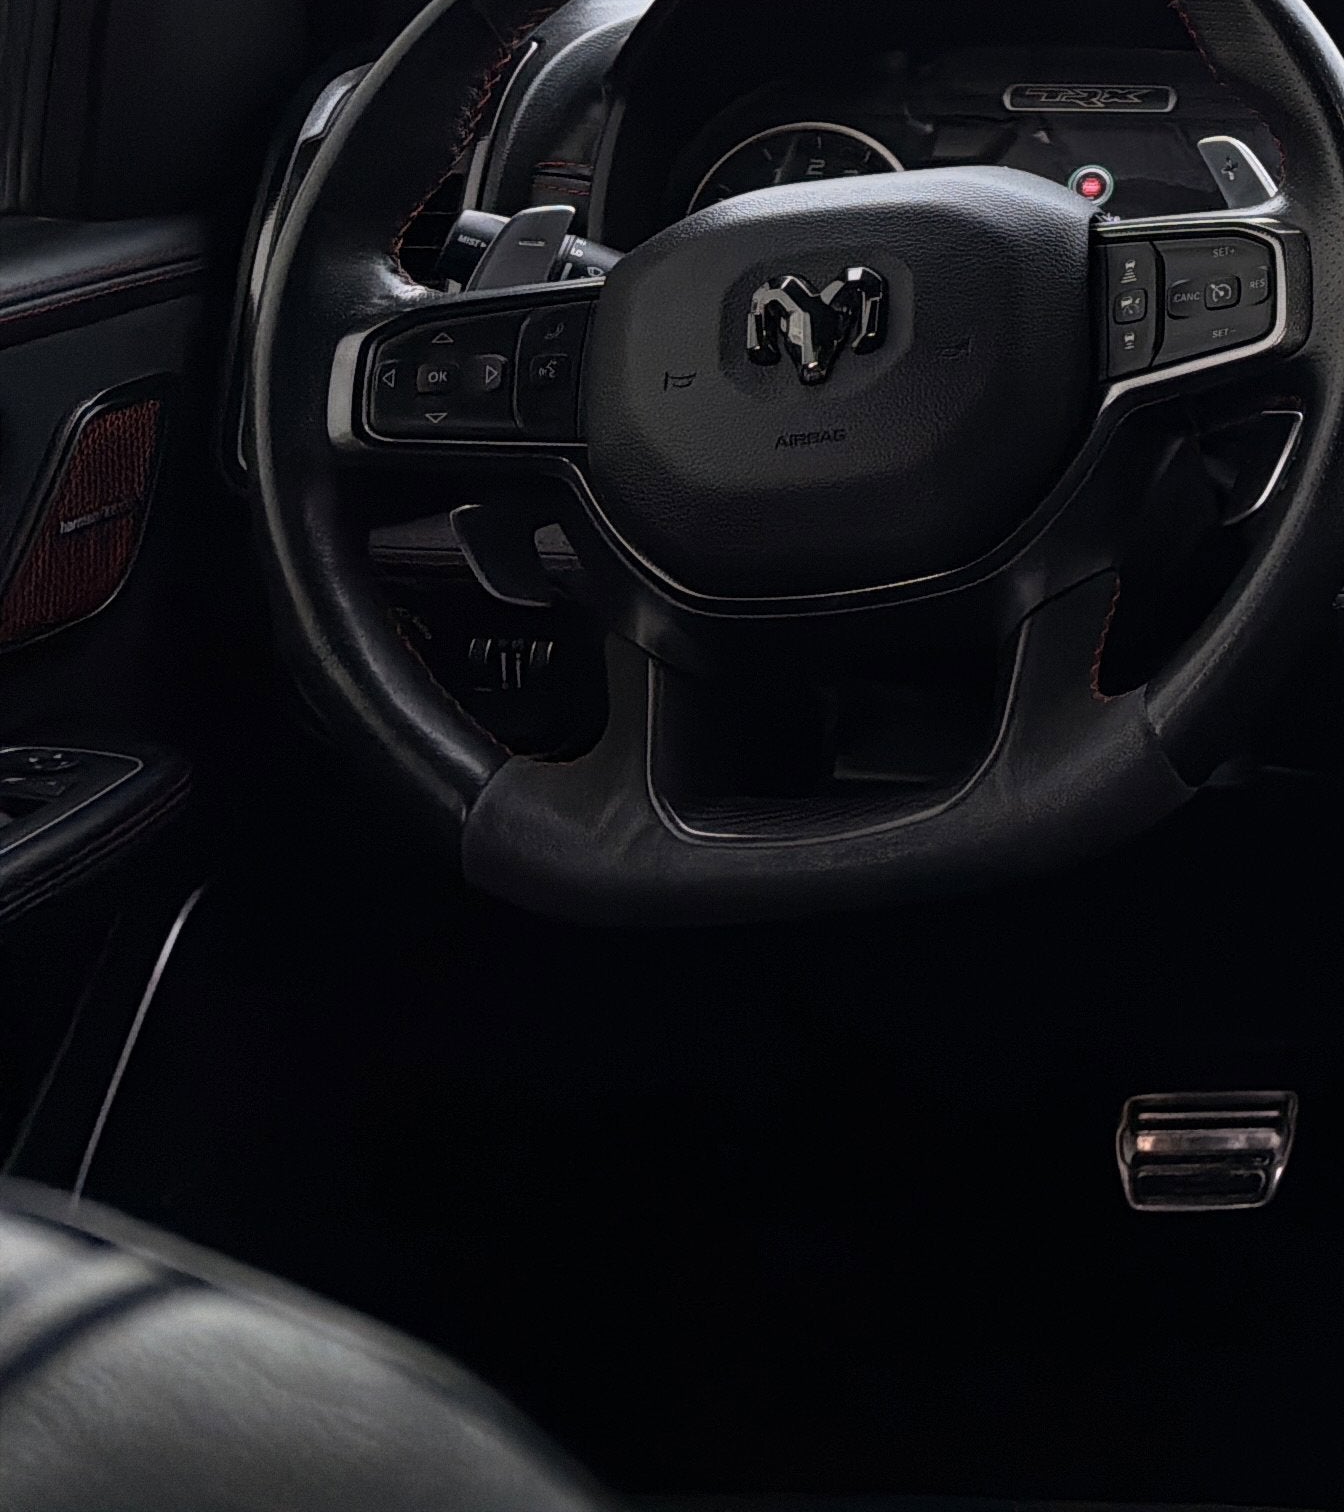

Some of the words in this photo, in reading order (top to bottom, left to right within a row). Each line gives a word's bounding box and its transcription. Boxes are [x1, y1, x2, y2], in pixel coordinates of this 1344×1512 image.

[1025, 88, 1153, 108] TRX
[1249, 278, 1267, 290] RES
[1174, 291, 1201, 303] CANC
[427, 369, 448, 384] OK
[774, 427, 847, 450] AIRBAG
